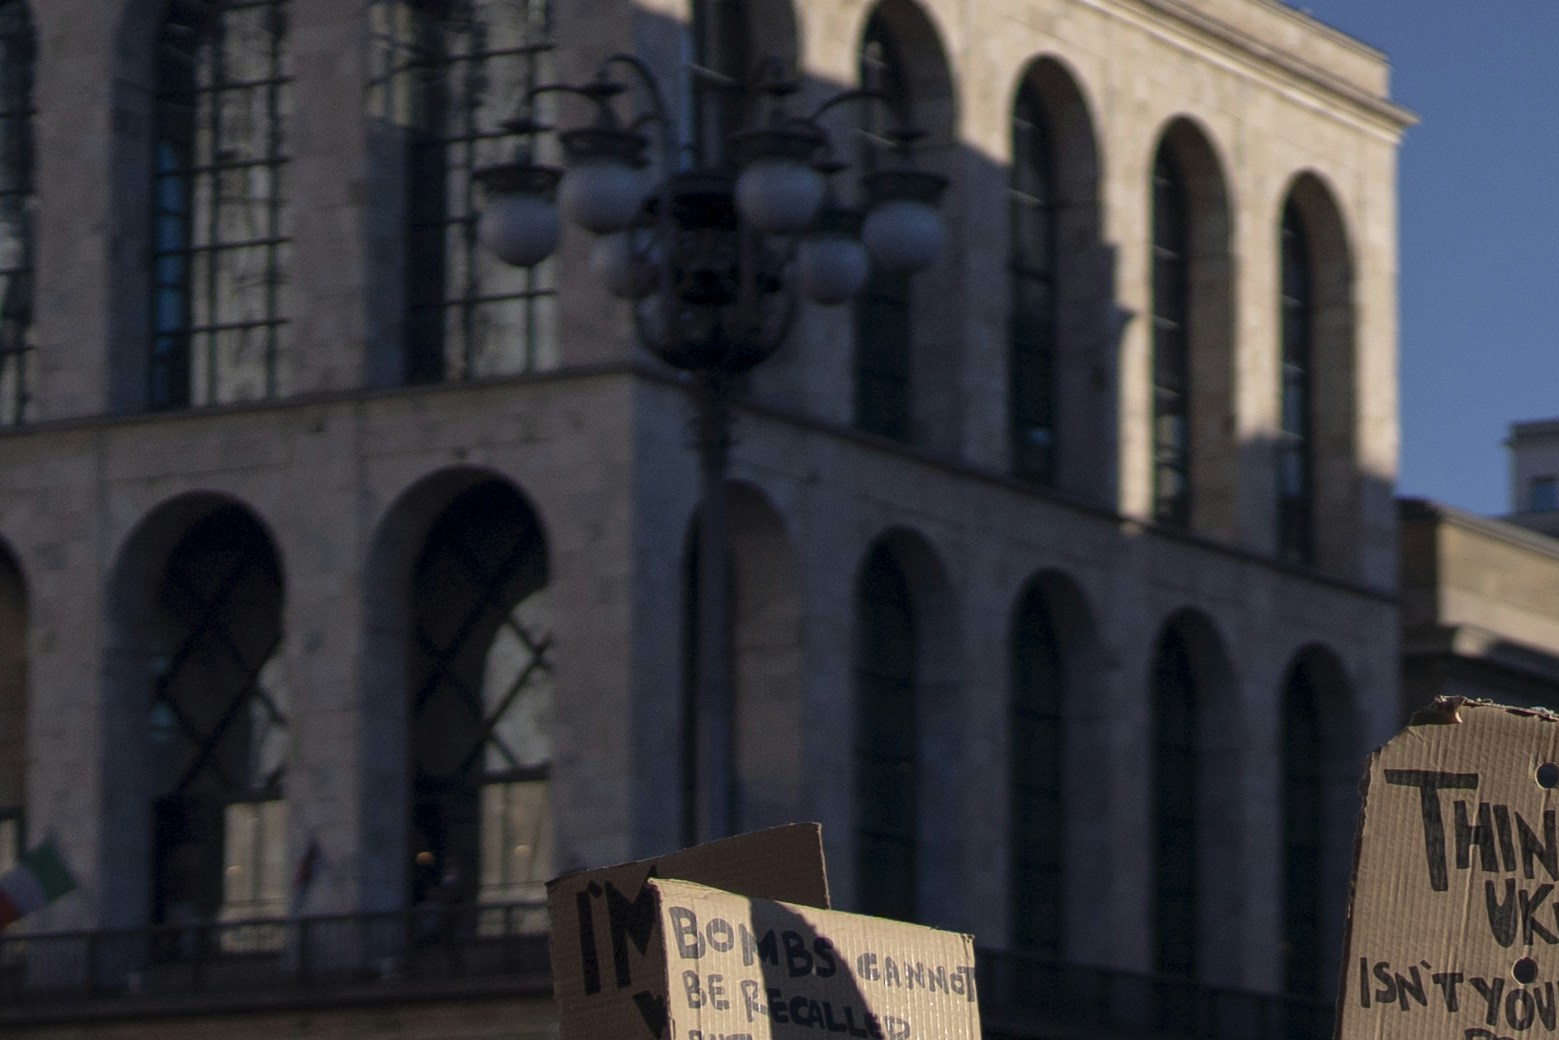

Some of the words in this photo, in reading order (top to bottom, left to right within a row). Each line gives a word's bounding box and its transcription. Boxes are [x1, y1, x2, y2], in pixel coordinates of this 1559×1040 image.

[668, 906, 837, 978] BOMBS
[857, 952, 976, 1003] CANNOT
[682, 969, 731, 1012] BE
[1359, 957, 1464, 1013] ISN'T
